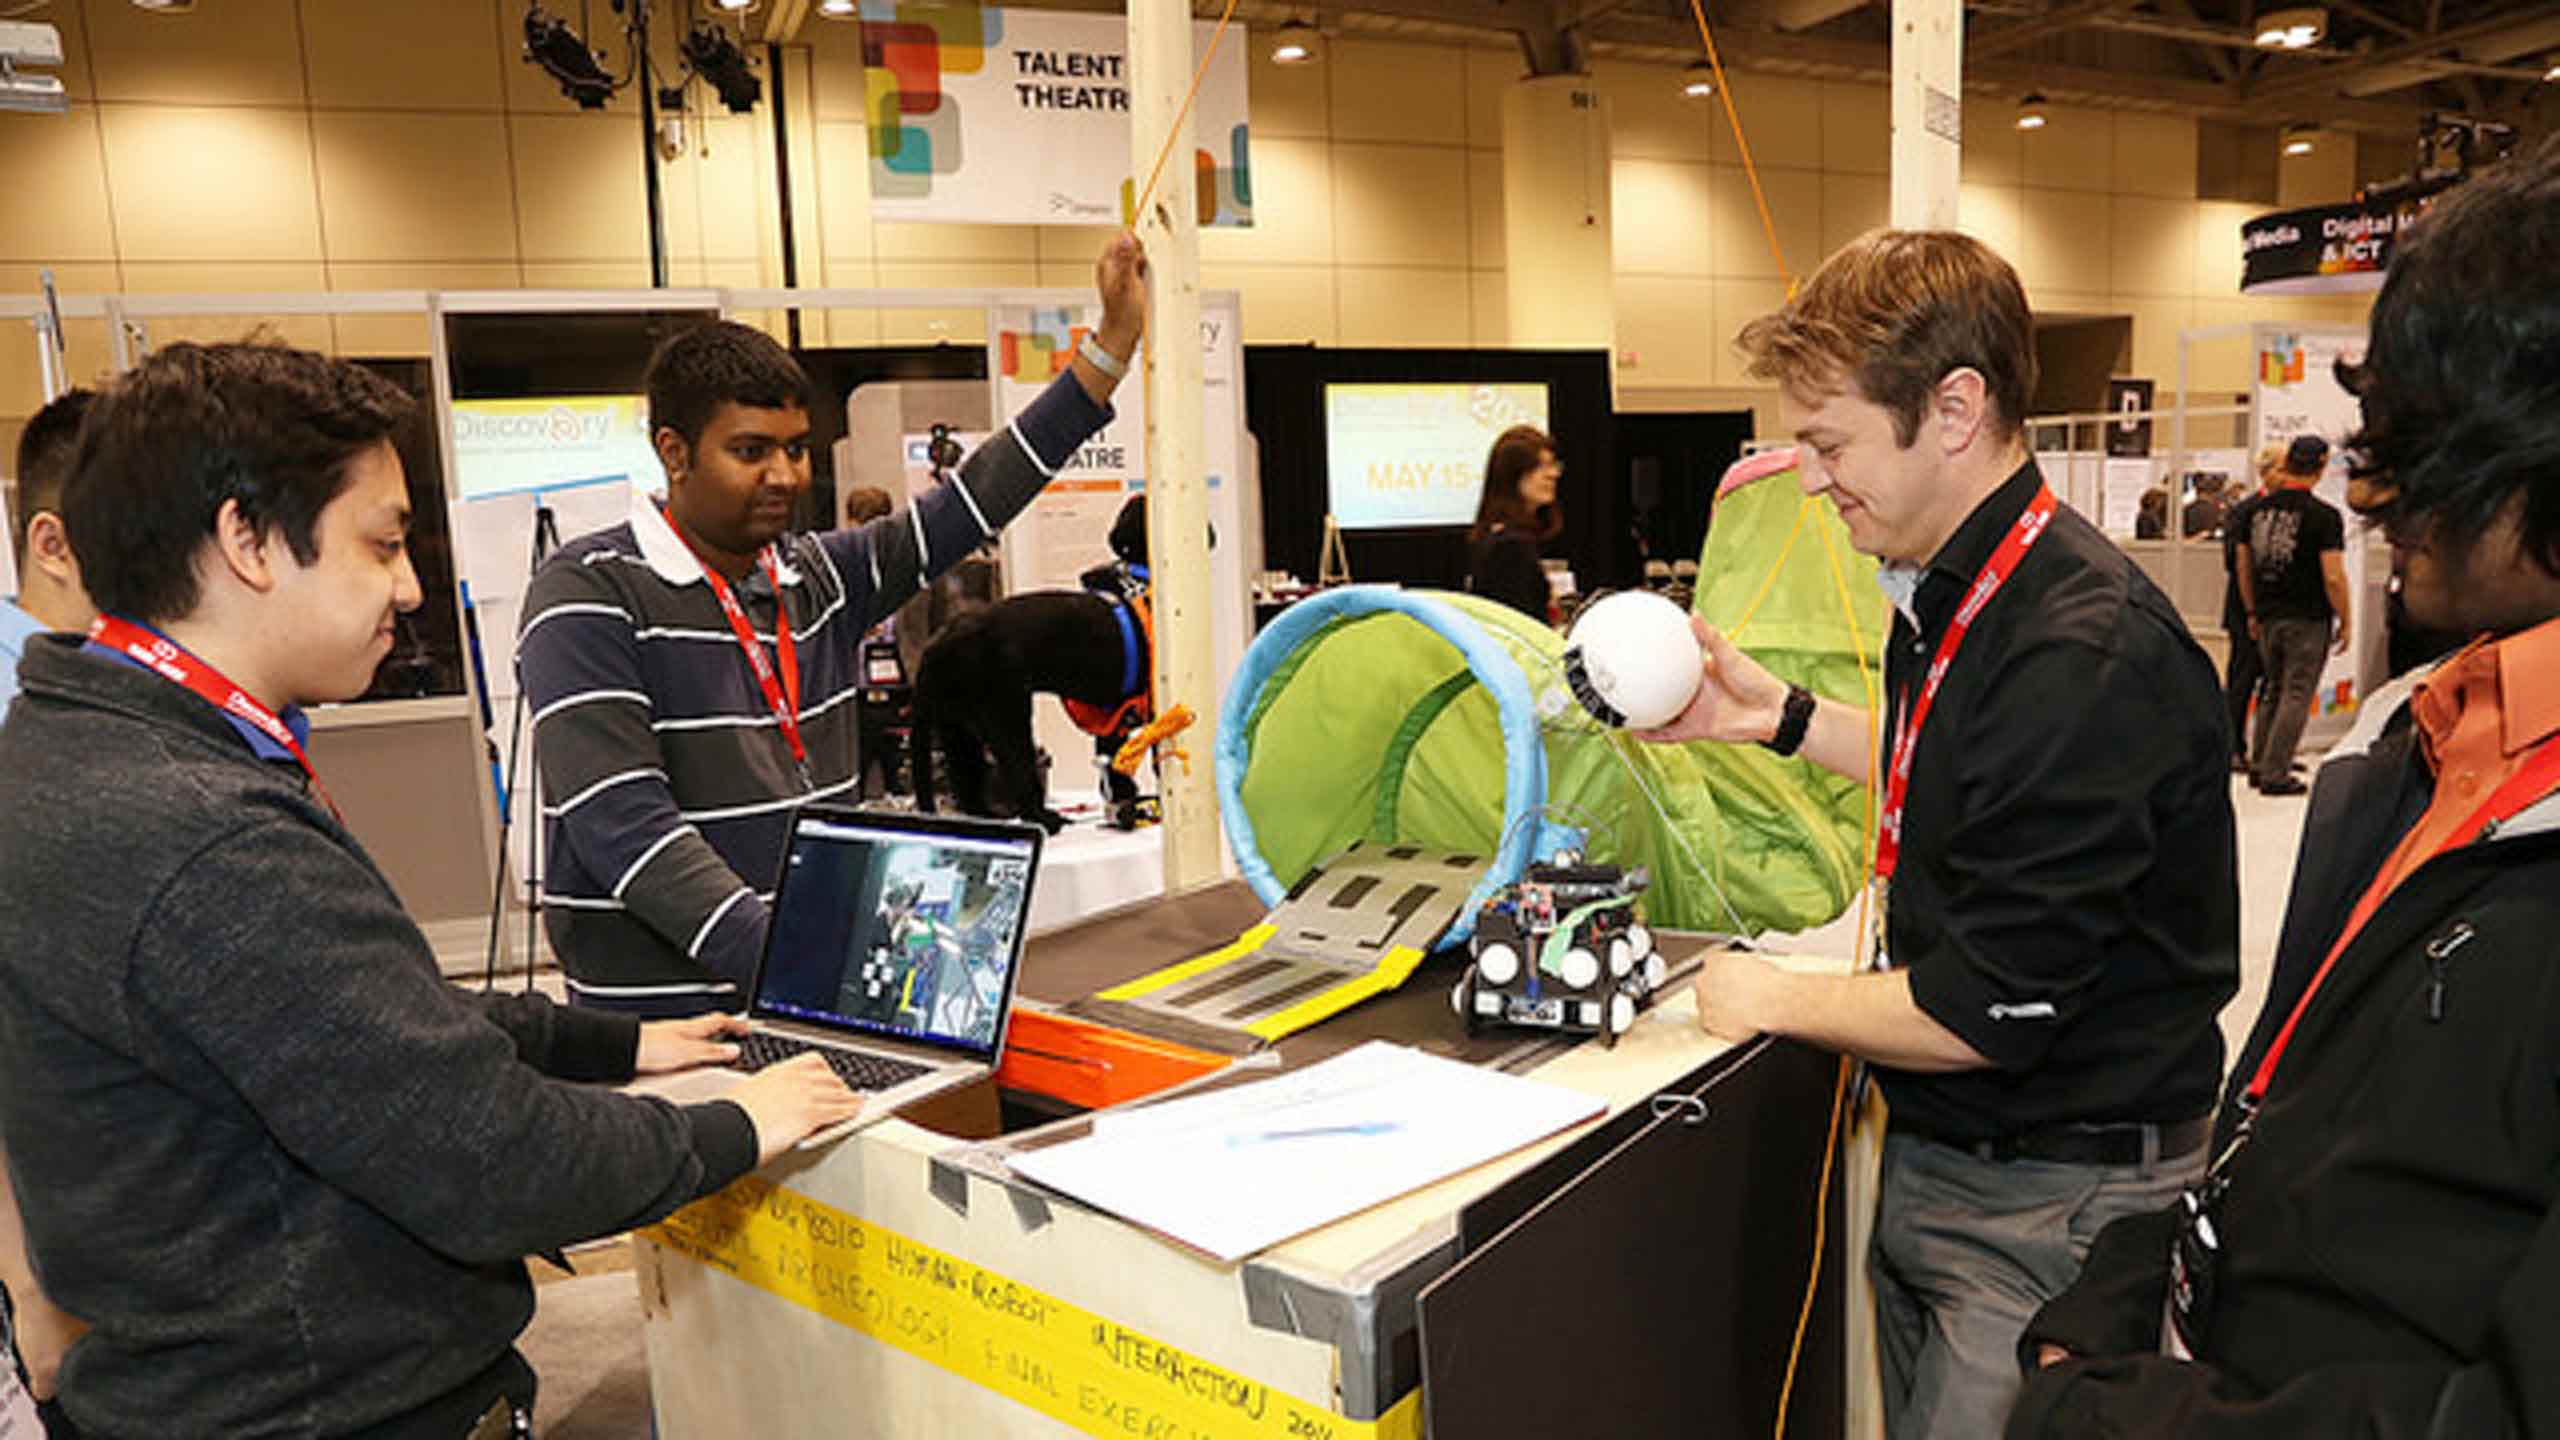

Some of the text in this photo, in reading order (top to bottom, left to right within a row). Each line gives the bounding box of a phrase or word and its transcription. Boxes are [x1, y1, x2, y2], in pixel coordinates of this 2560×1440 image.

[1012, 50, 1122, 78] TALENT
[1015, 83, 1130, 112] THEATR
[2322, 212, 2393, 241] Digital
[1068, 447, 1126, 470] ATRE
[1366, 462, 1483, 491] MAY 15-
